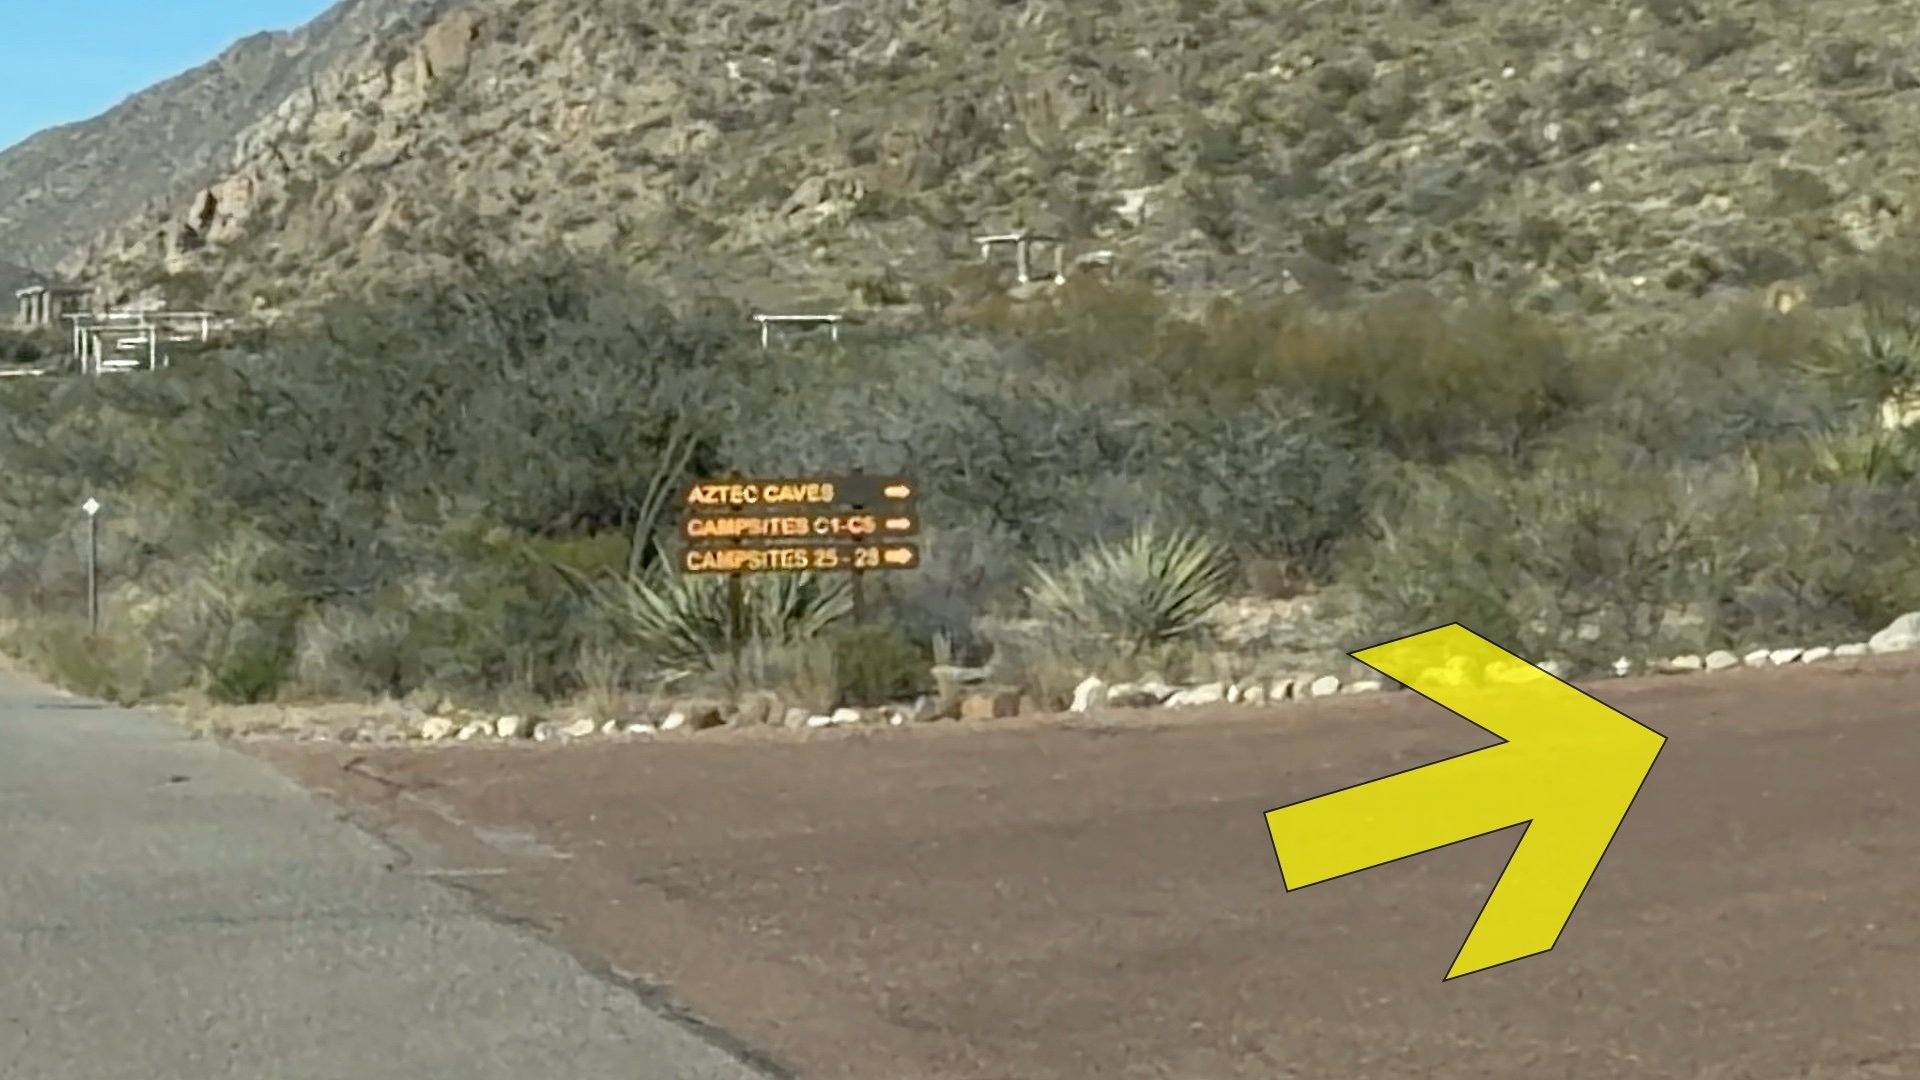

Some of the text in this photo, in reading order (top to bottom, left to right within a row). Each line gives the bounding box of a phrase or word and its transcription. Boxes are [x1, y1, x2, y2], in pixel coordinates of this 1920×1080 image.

[688, 483, 834, 503] AZTEC CAVES
[687, 518, 809, 536] CAMPSITES
[686, 549, 809, 570] CAMPSITES
